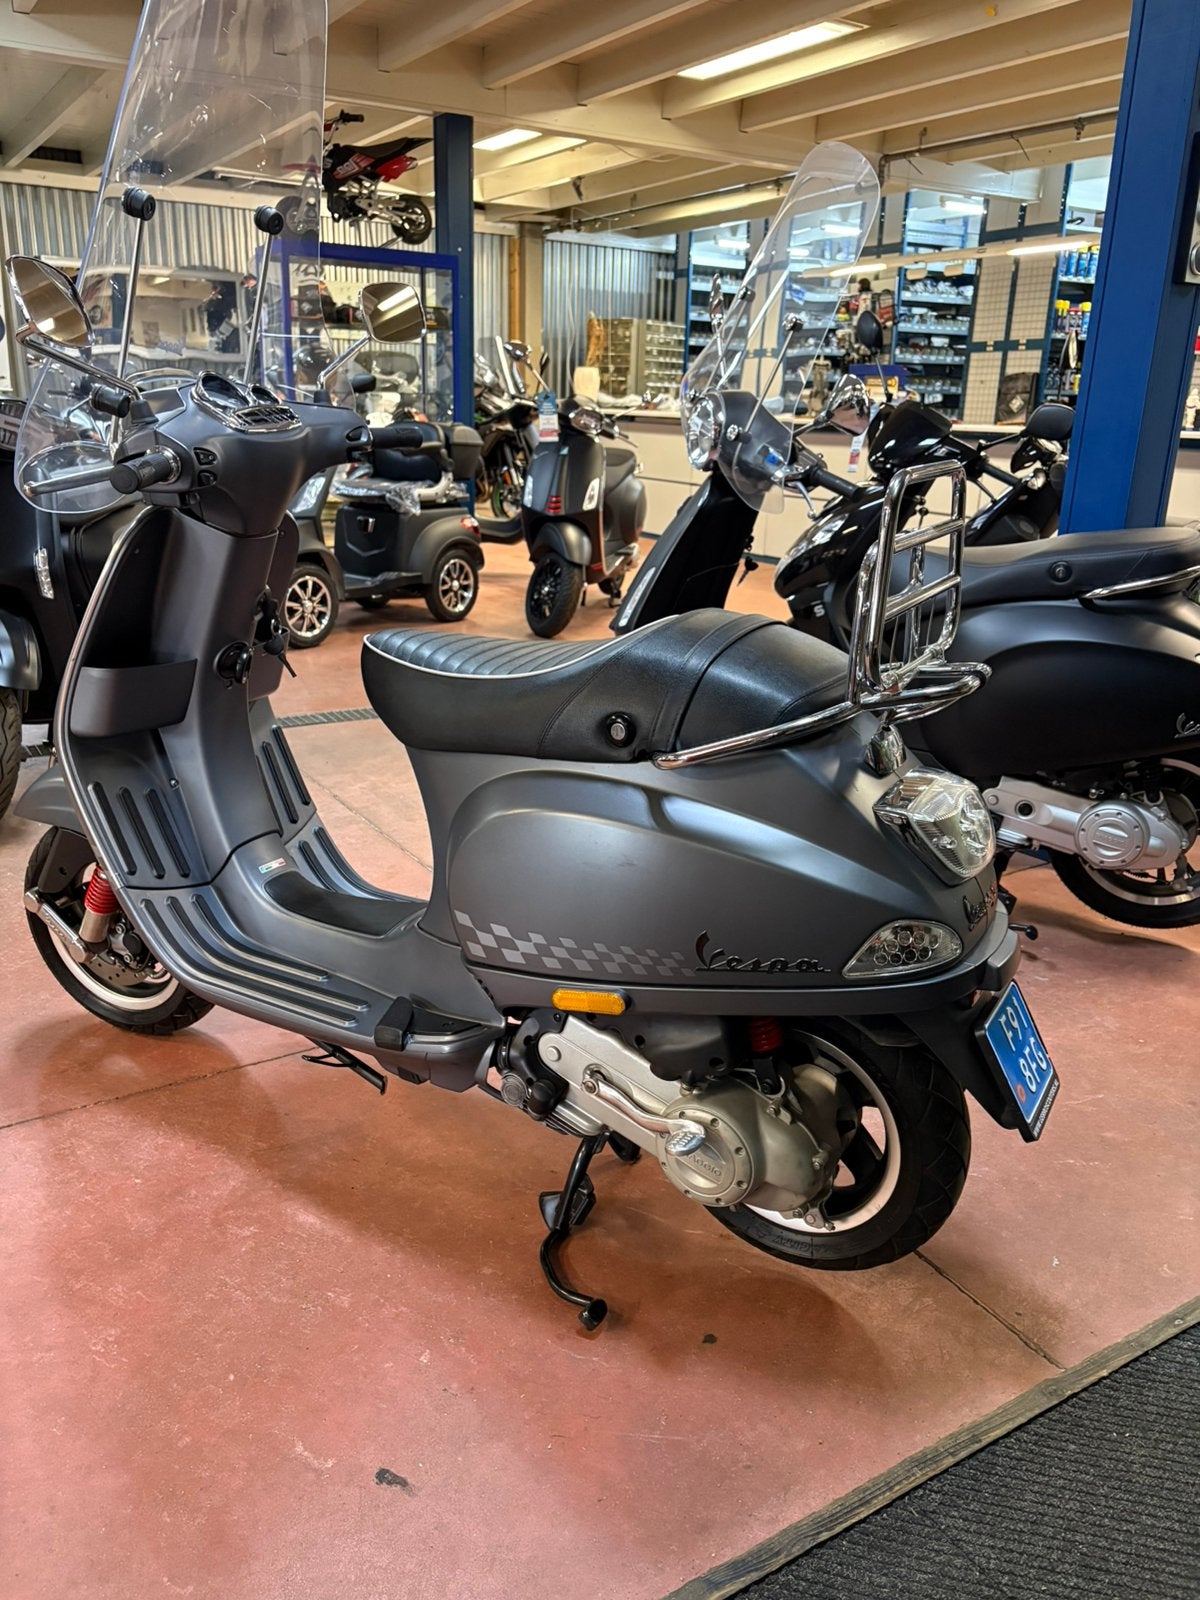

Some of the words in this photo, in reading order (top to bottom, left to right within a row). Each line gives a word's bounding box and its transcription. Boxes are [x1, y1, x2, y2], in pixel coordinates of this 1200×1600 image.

[695, 929, 832, 974] Vespa
[998, 996, 1028, 1051] F91
[1018, 1037, 1047, 1093] 8FG
